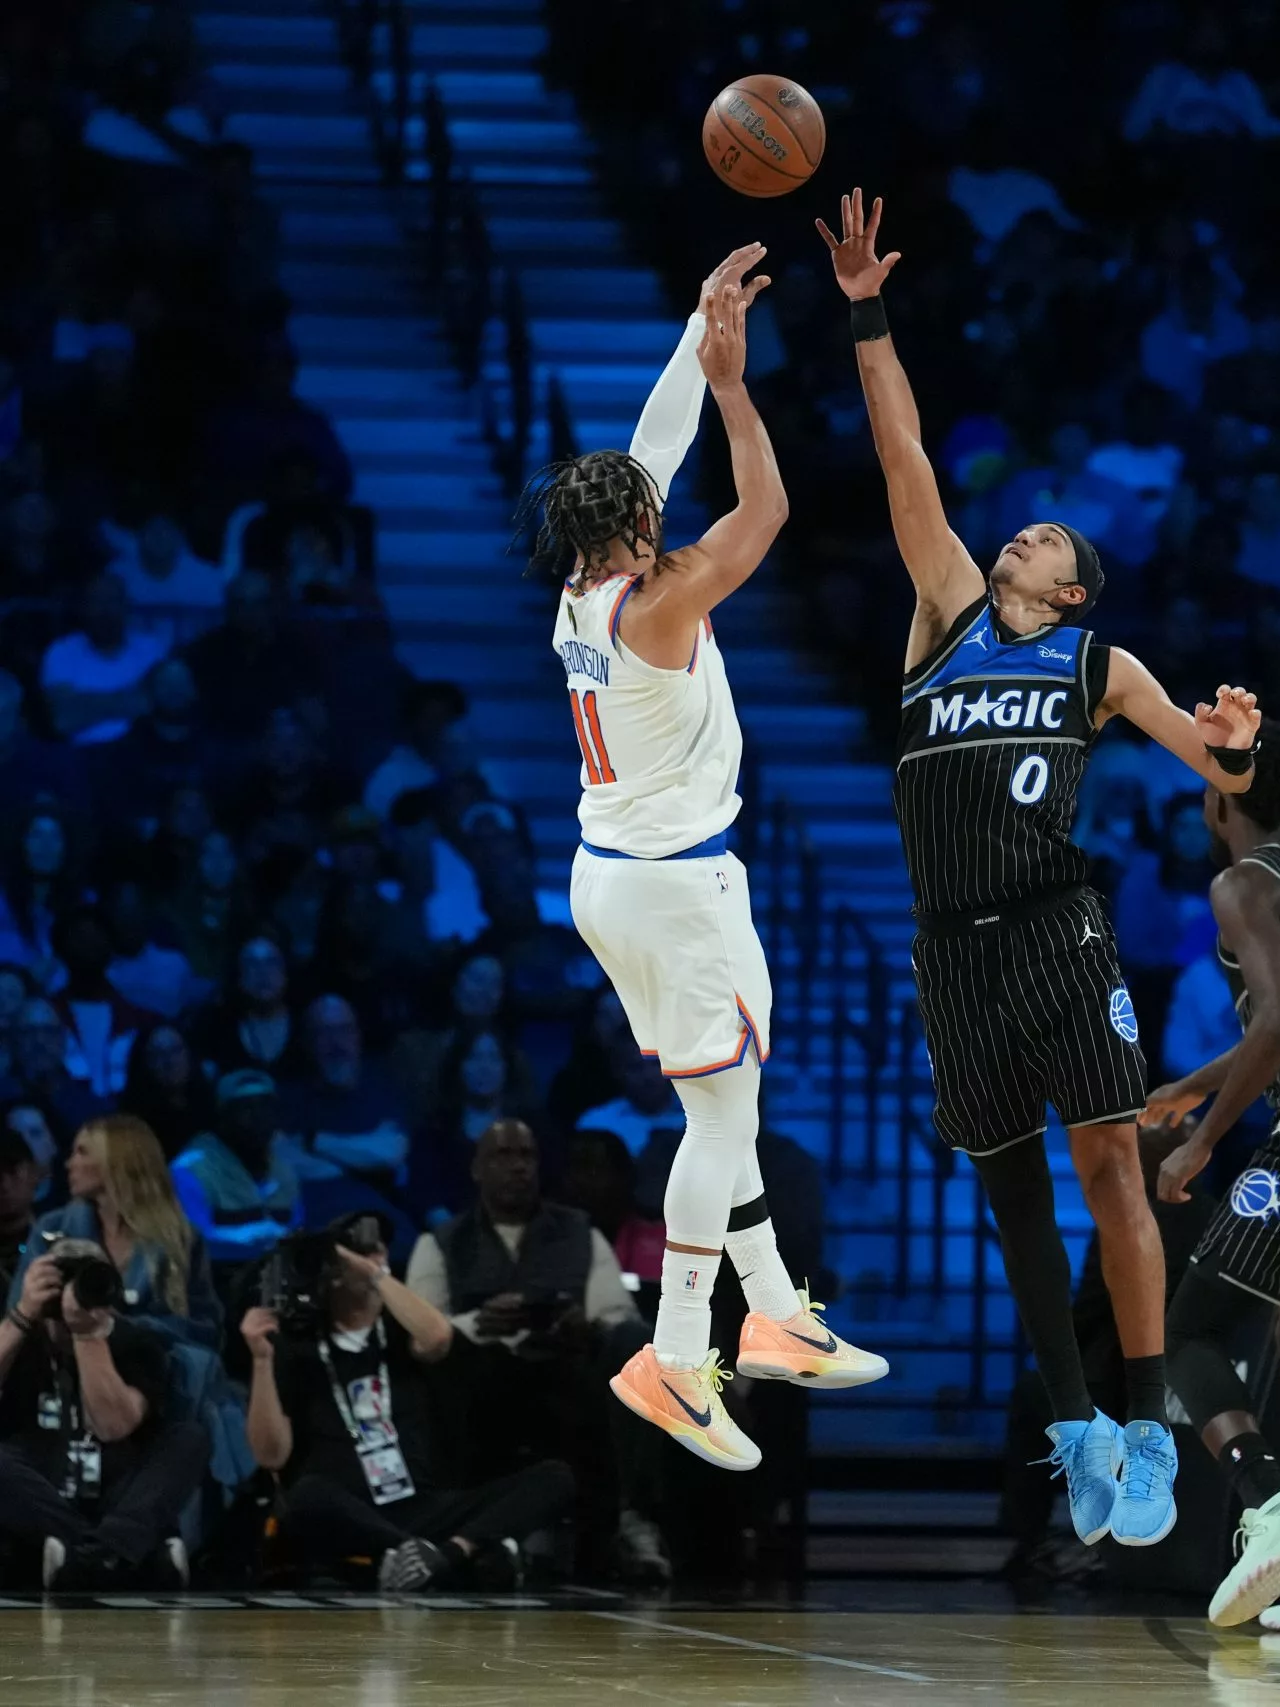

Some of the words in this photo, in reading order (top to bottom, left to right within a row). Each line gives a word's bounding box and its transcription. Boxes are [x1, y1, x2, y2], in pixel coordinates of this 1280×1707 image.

[728, 95, 789, 161] Wilson
[1036, 644, 1073, 664] Disney
[570, 688, 617, 785] 11
[1010, 755, 1049, 804] 0
